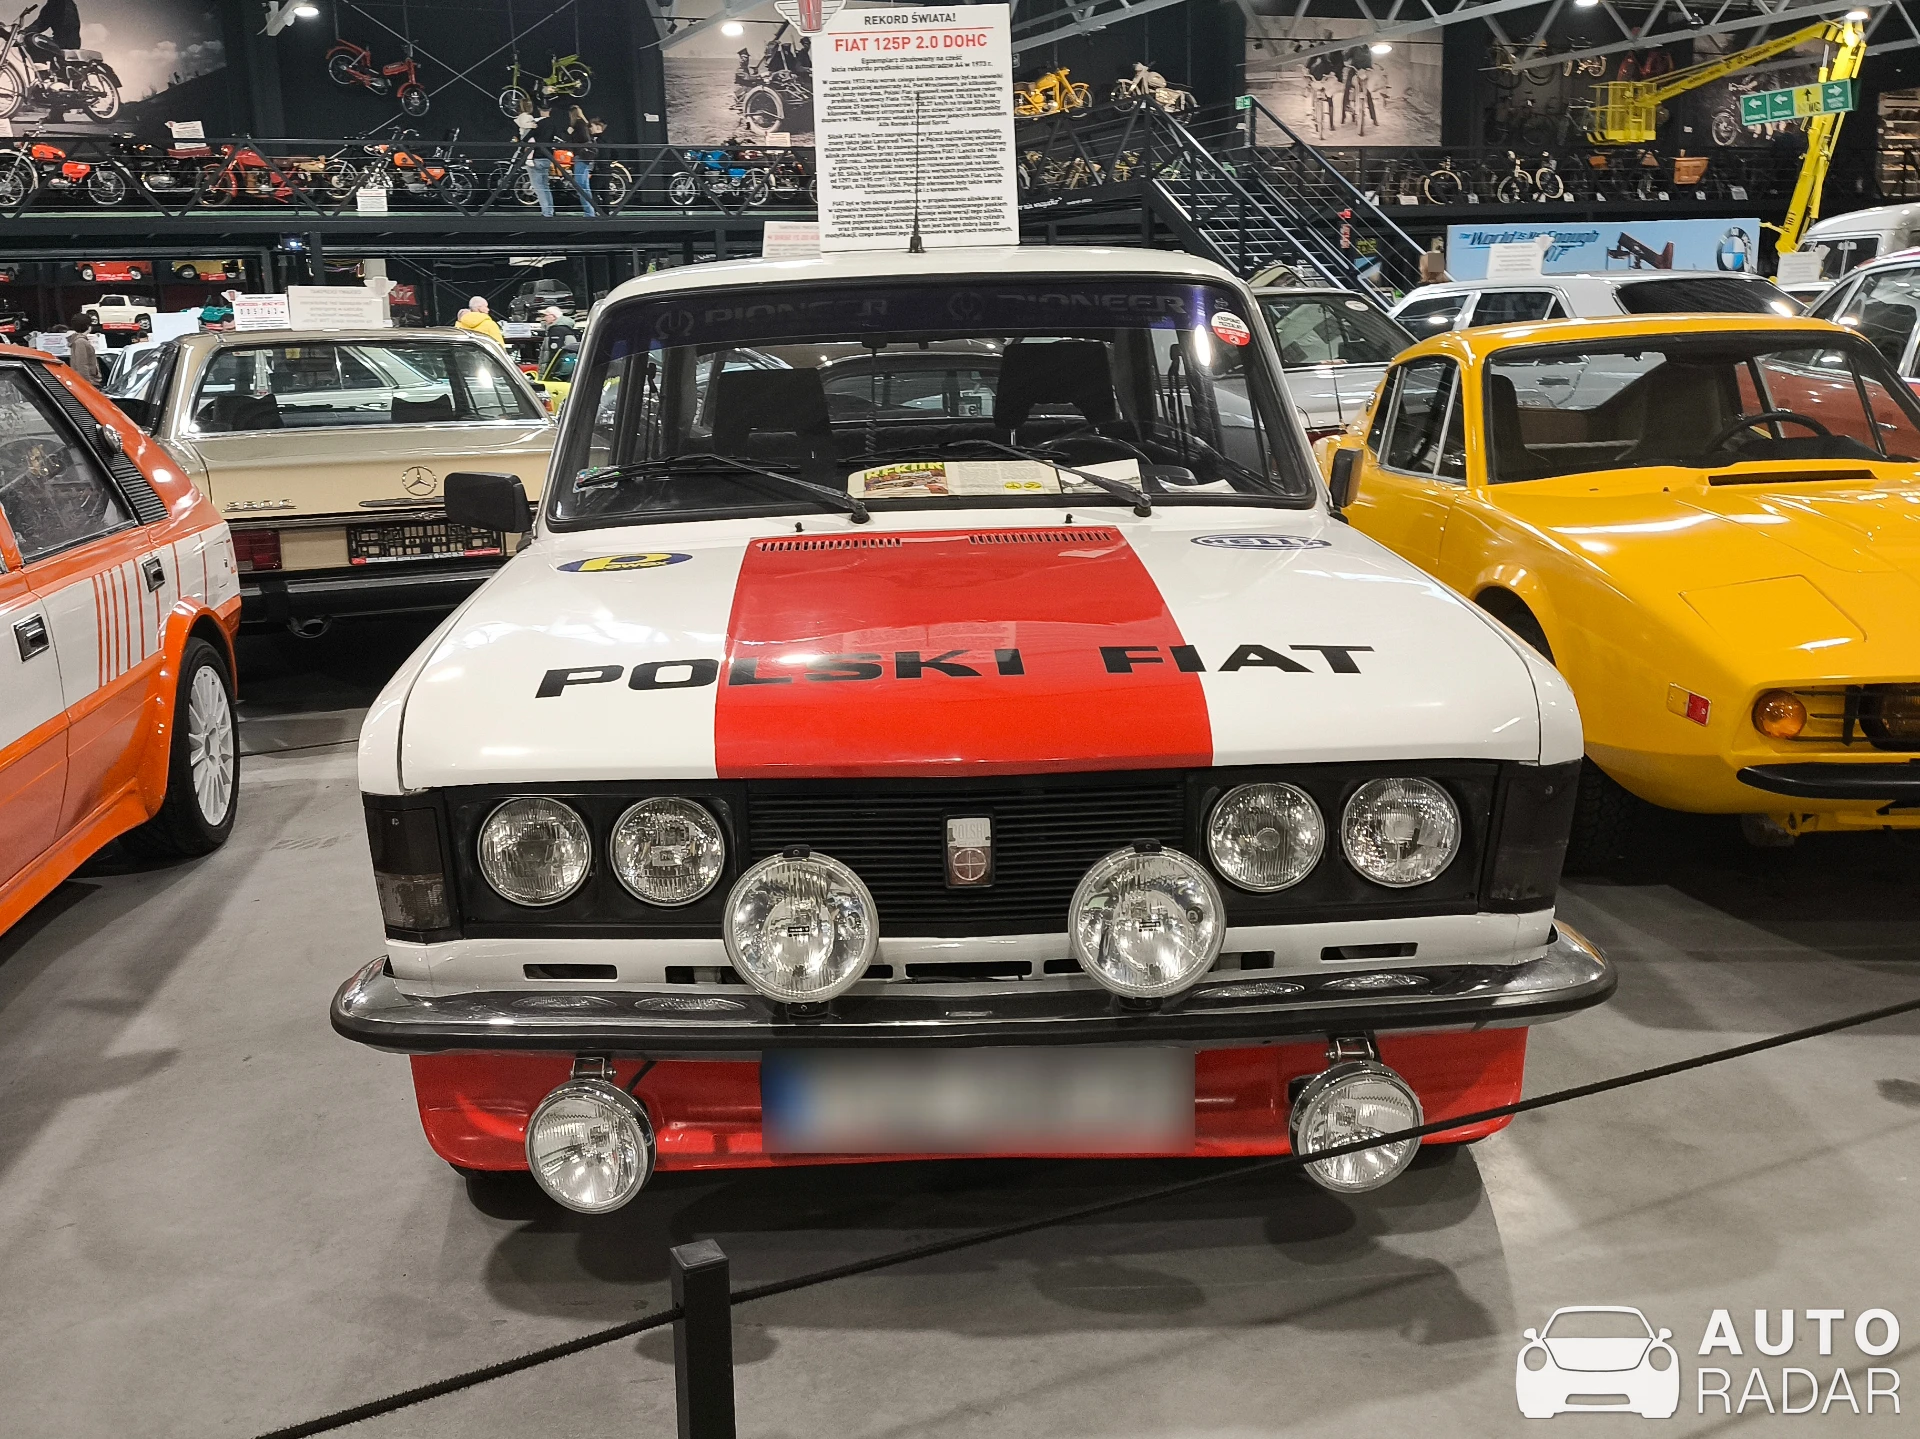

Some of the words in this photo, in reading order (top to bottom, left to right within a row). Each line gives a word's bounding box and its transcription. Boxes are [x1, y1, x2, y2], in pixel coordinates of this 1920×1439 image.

[864, 14, 909, 25] REKORD
[911, 11, 956, 23] ŚWIATA!
[835, 38, 869, 52] FIAT
[874, 36, 911, 51] 125P
[916, 35, 939, 49] 2.0
[944, 33, 987, 48] DOHC
[535, 648, 1026, 699] POLSKI
[1098, 644, 1376, 674] FIAT
